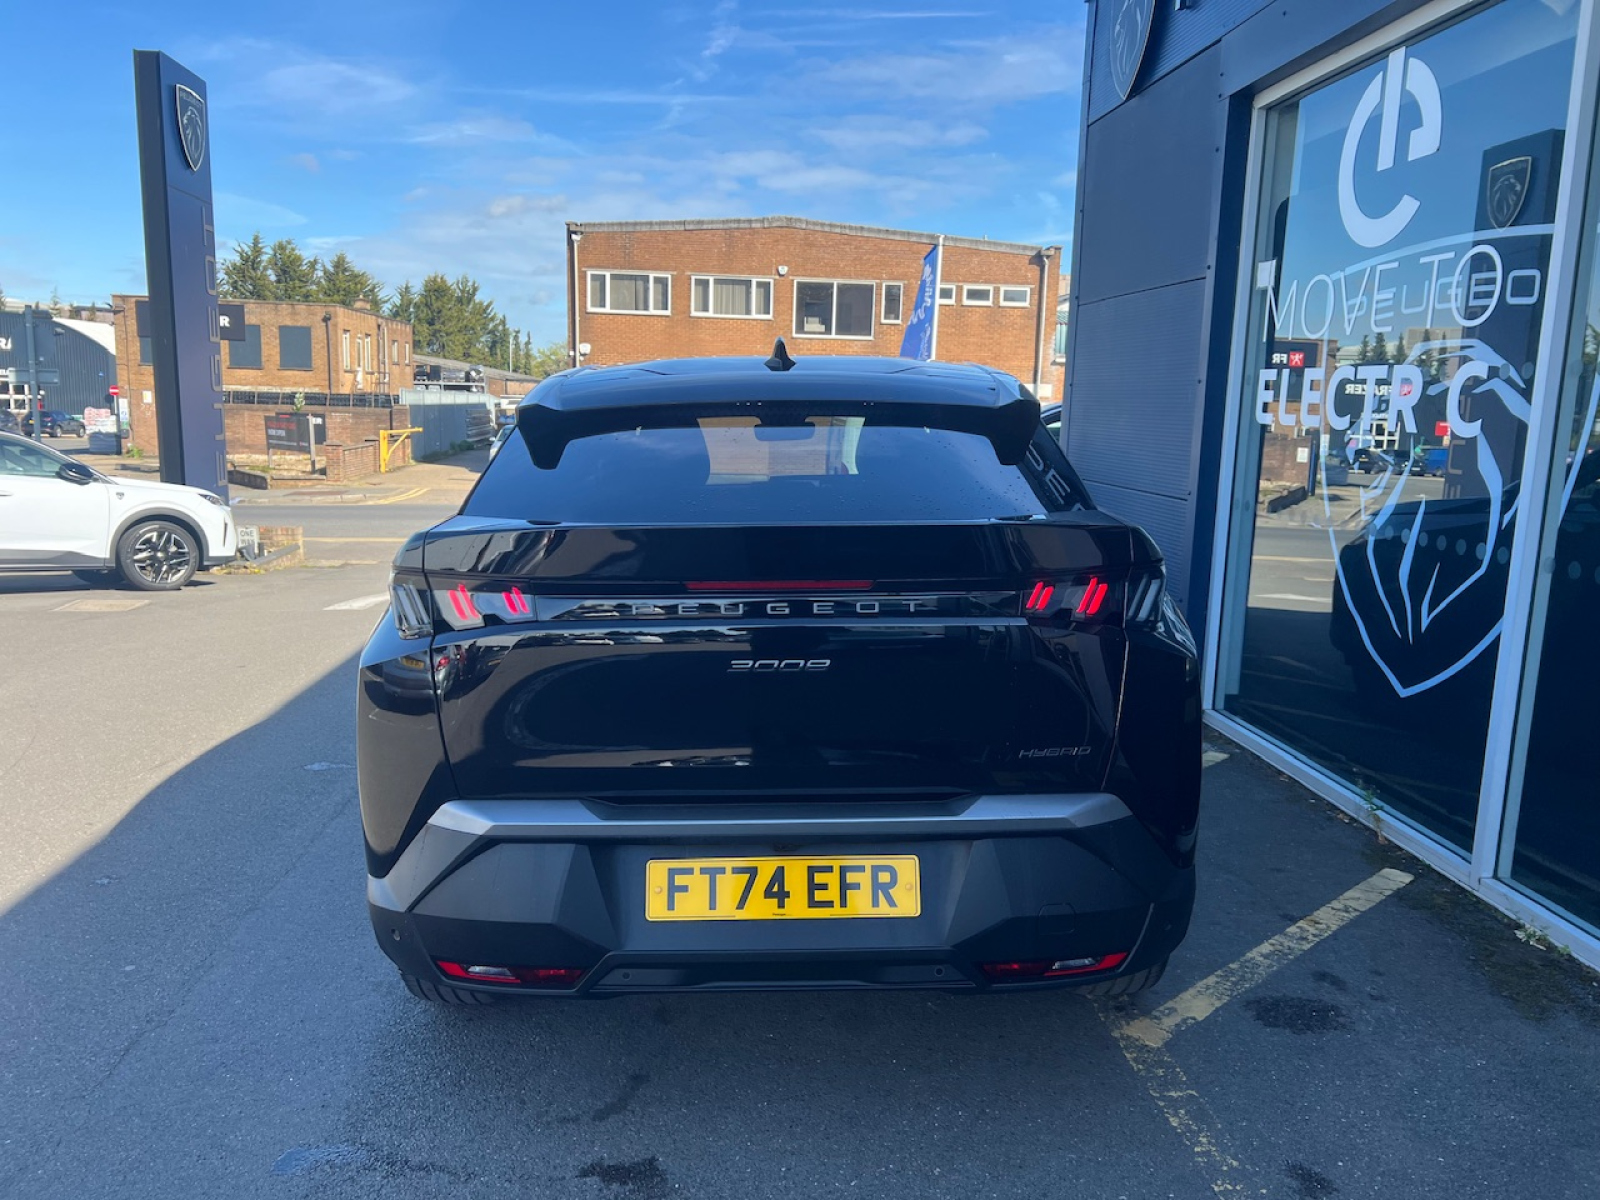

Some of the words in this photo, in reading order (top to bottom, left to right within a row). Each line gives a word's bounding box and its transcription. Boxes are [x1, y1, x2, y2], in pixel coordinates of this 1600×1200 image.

[1263, 262, 1399, 341] MOVE
[1420, 244, 1503, 328] TO
[631, 600, 923, 616] PEUGEOT
[727, 659, 831, 672] 3008
[1018, 746, 1092, 759] HYBRID
[667, 865, 790, 911] FT74
[807, 864, 898, 908] EFR
